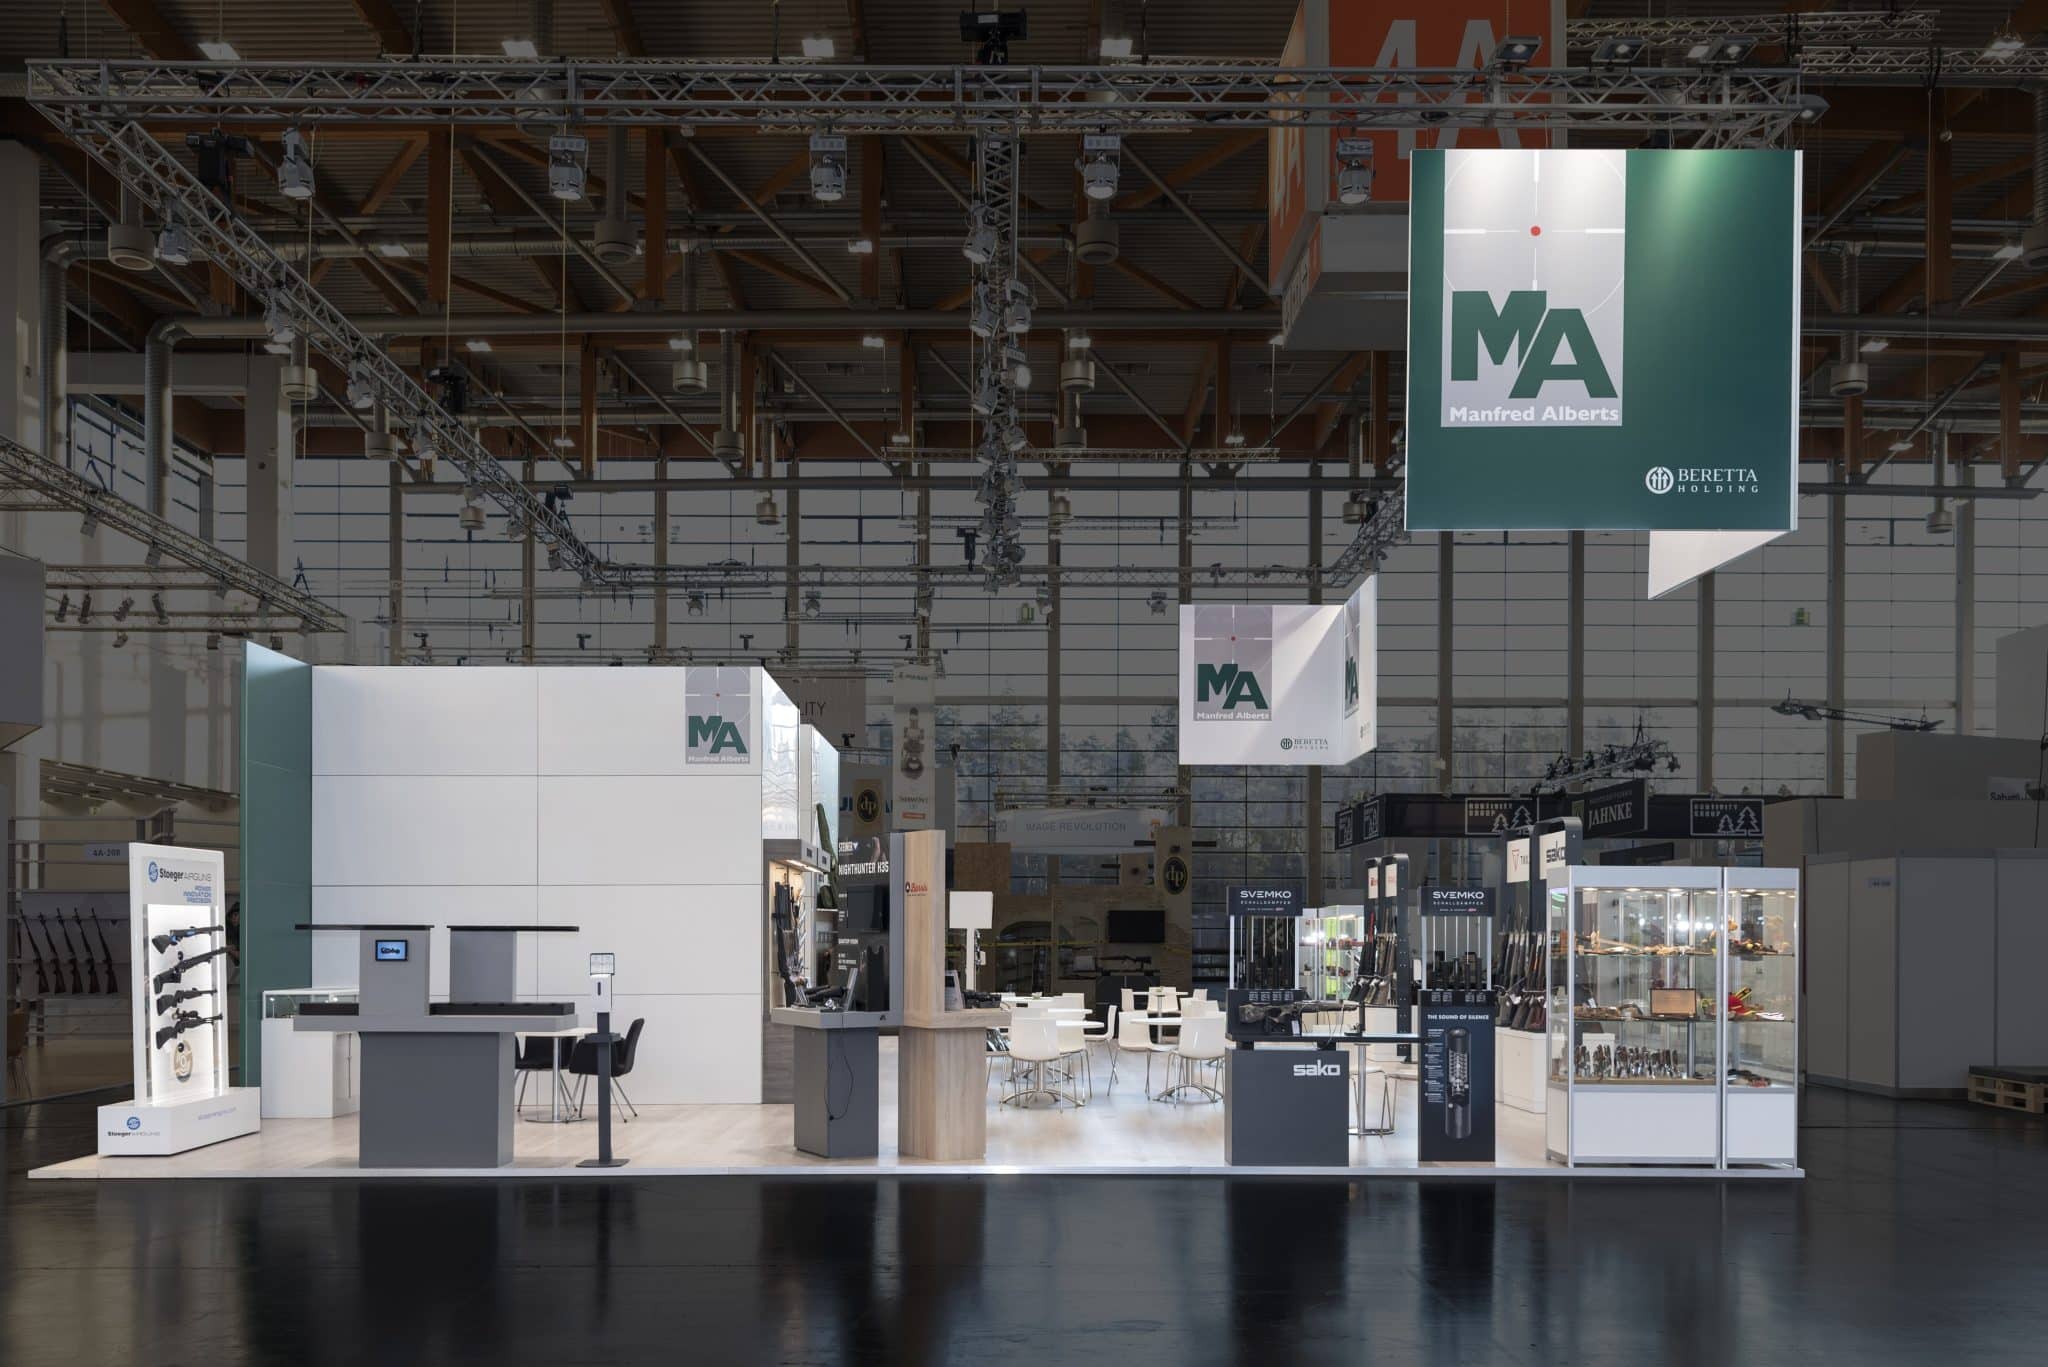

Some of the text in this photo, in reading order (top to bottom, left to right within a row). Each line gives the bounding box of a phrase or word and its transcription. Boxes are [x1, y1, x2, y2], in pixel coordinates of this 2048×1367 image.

[1451, 291, 1618, 399] MA
[1450, 406, 1619, 422] Manfred Alberts
[1678, 468, 1758, 482] BERETTA
[1678, 485, 1758, 493] HOLDING
[1197, 663, 1268, 709] MA
[1197, 711, 1269, 719] Manfred Alberts
[688, 715, 748, 753] MA
[1588, 802, 1633, 830] JAHNKE
[159, 867, 183, 882] Stoeger
[838, 862, 875, 875] NIGHTHUNTER
[1240, 890, 1291, 898] SVEMKO
[1433, 891, 1484, 899] SVEMKO
[1293, 1059, 1341, 1076] sako
